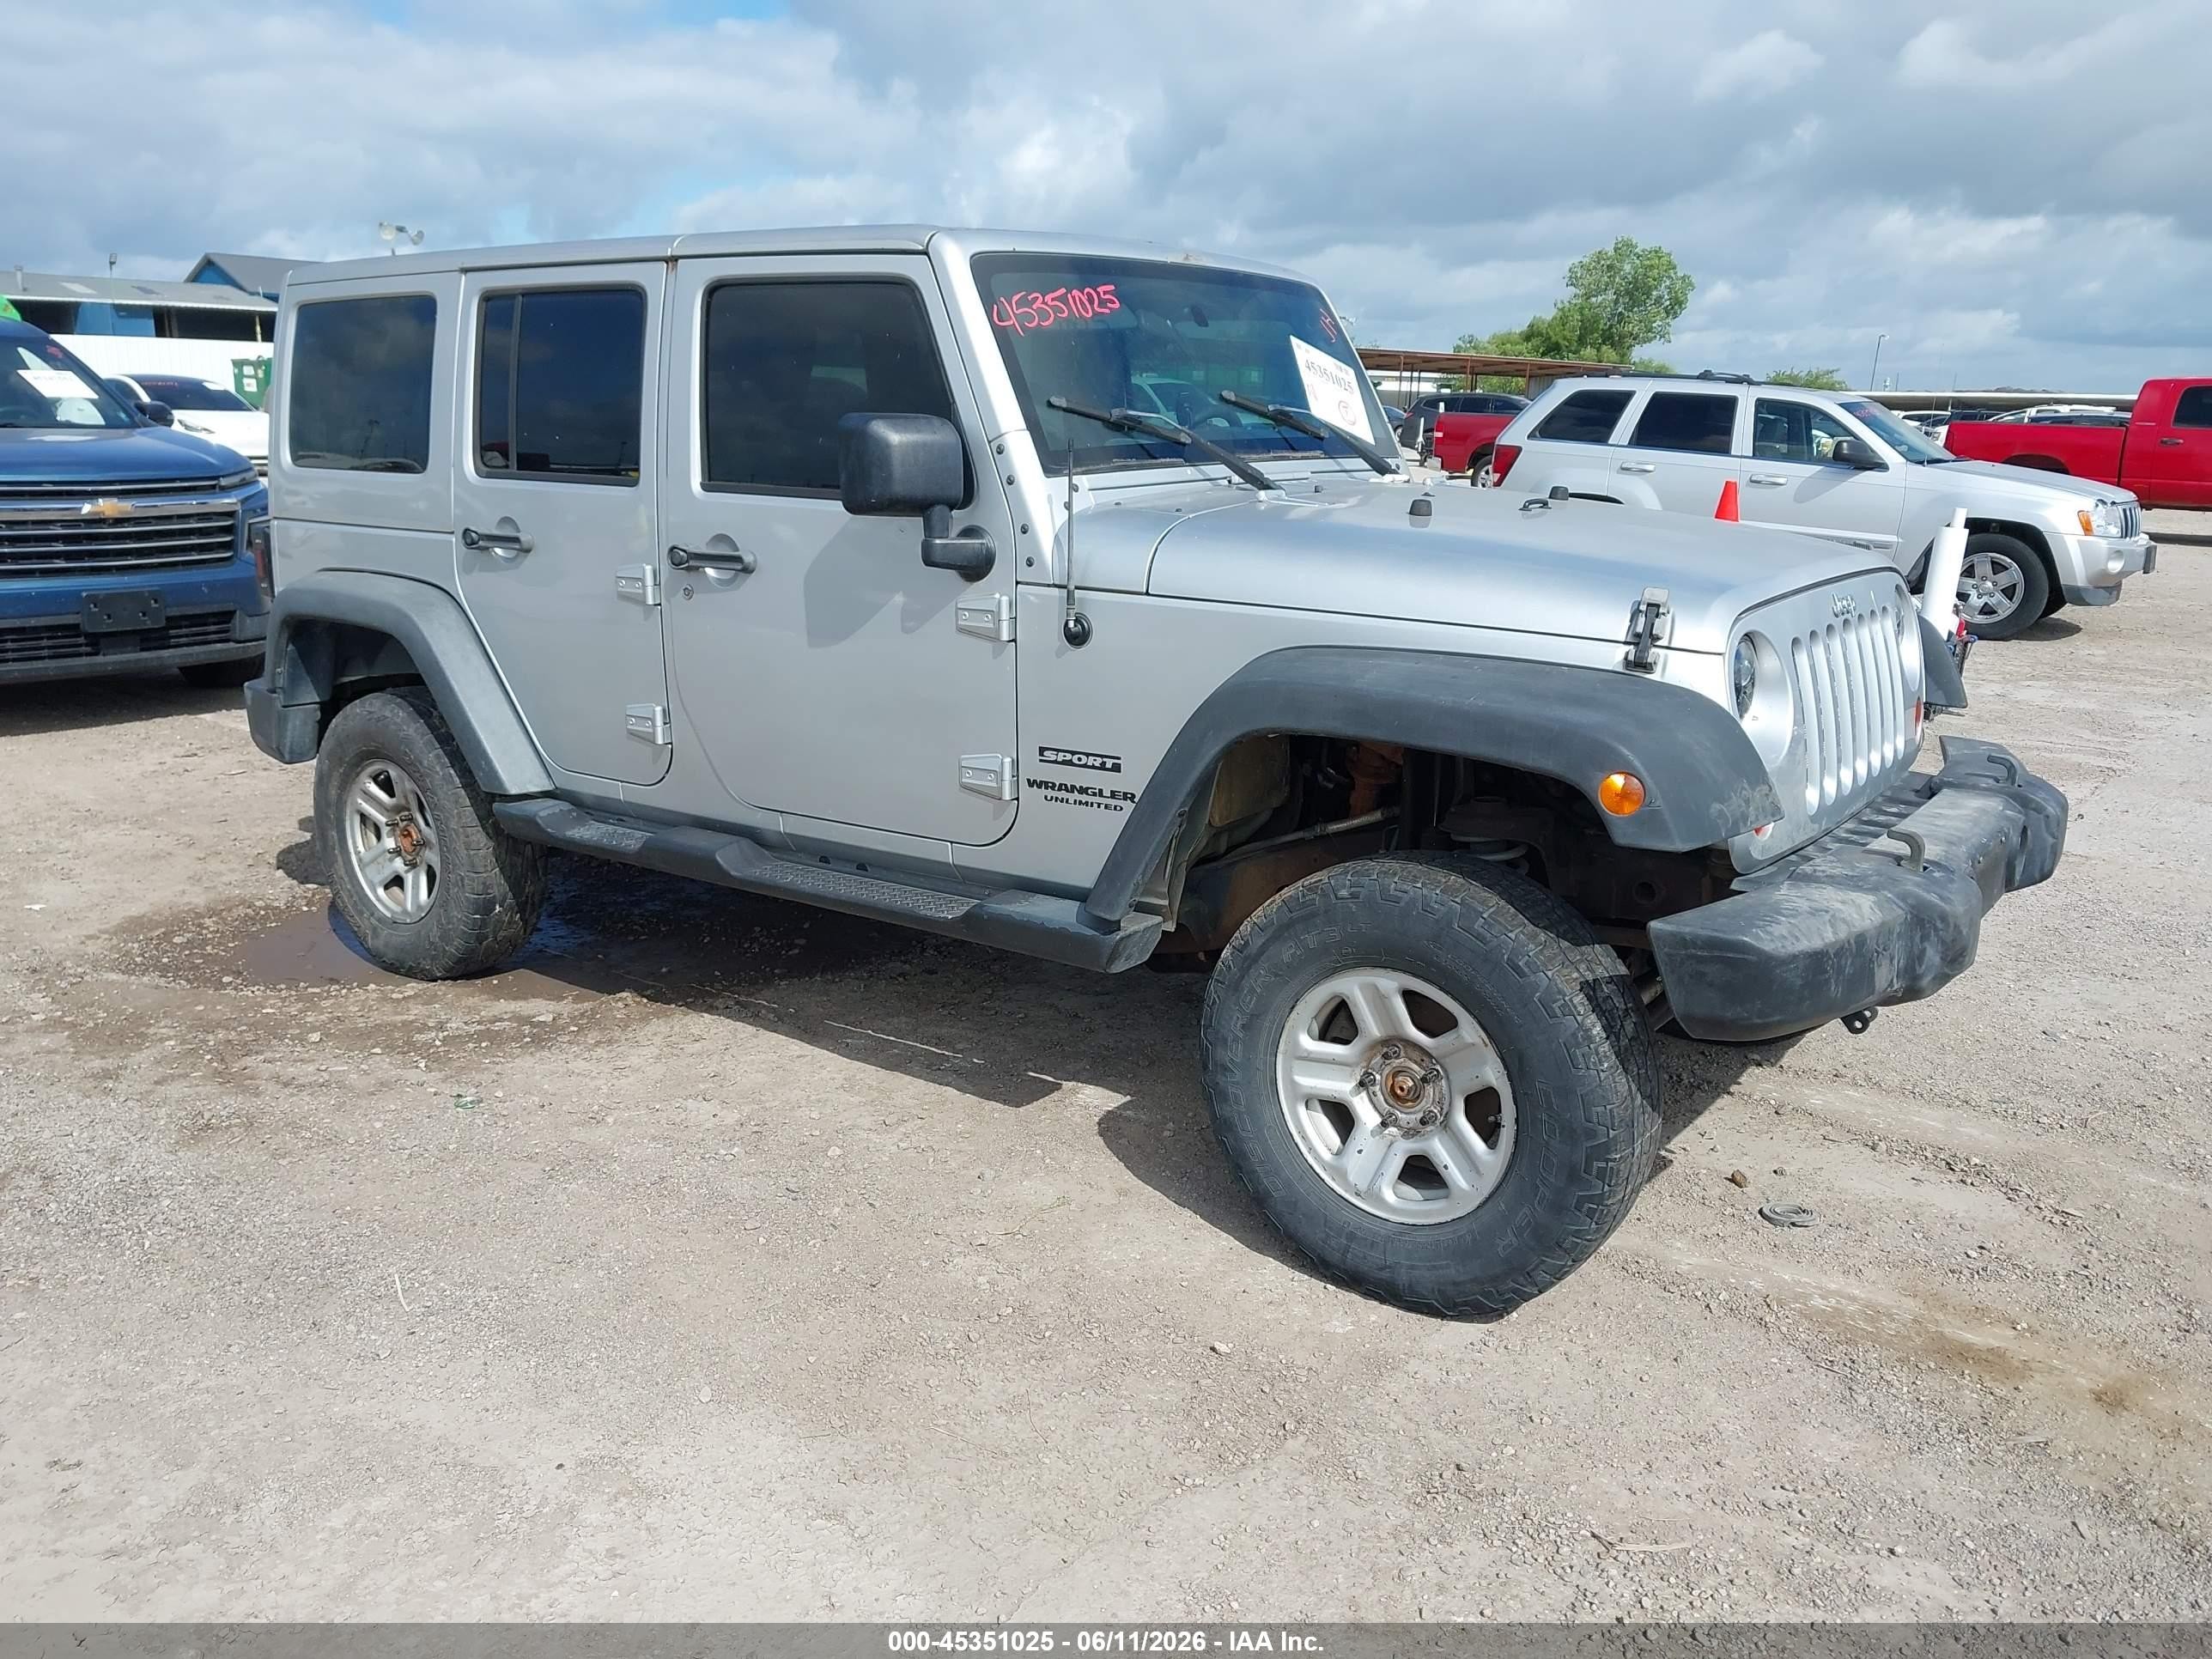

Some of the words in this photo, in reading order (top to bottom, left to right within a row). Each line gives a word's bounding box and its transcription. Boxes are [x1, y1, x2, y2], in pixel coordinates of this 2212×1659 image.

[993, 284, 1120, 337] 45351025
[1304, 359, 1354, 395] 45351025
[1832, 592, 1856, 618] Jeep
[1040, 749, 1121, 770] SPORT
[1026, 778, 1136, 804] WRANGLER
[1044, 794, 1124, 811] UNLIMITED
[1227, 965, 1285, 1198] DISCOVERER
[1498, 1078, 1560, 1259] COOPER
